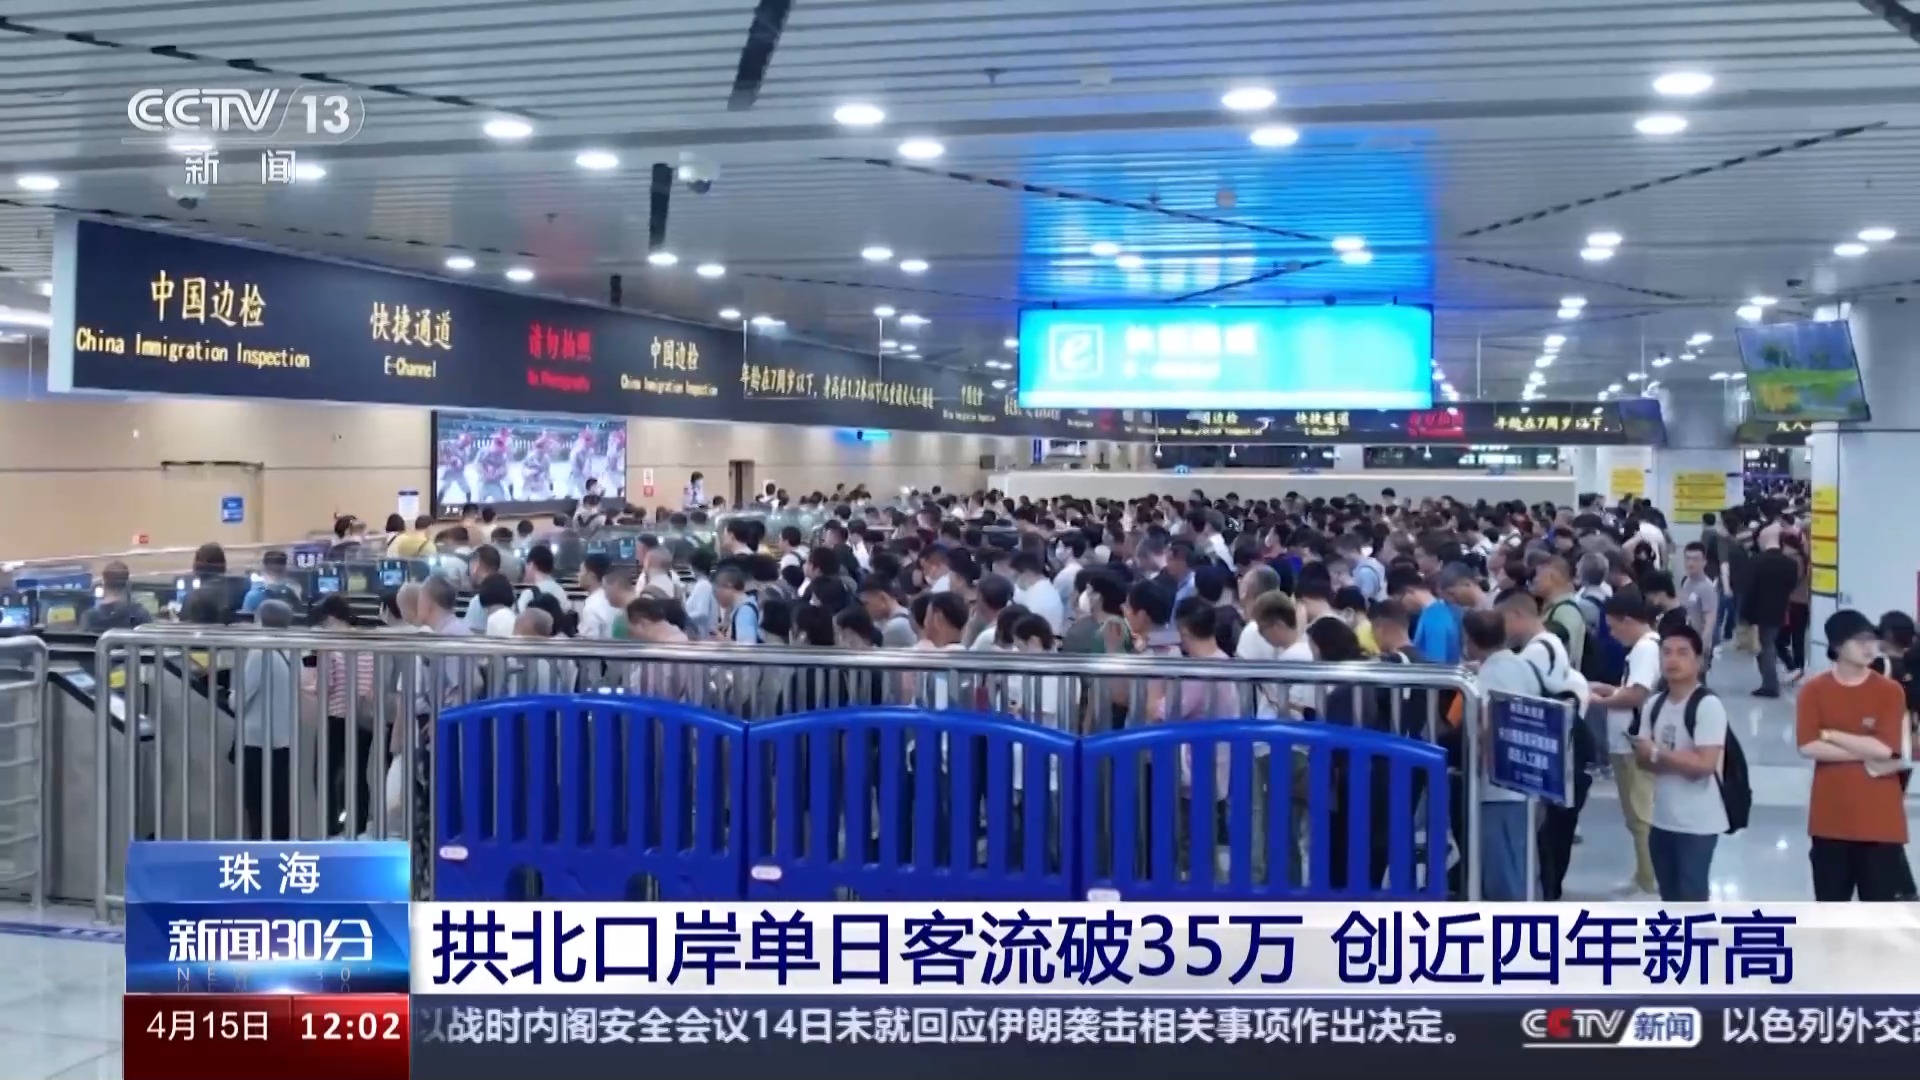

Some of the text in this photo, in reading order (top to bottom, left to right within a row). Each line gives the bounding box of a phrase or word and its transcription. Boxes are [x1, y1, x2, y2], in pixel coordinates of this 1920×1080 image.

[150, 269, 266, 328] 中国边检
[76, 327, 310, 369] China Immigration Inspection
[369, 301, 453, 350] 快捷通道
[650, 335, 699, 371] 中国边检
